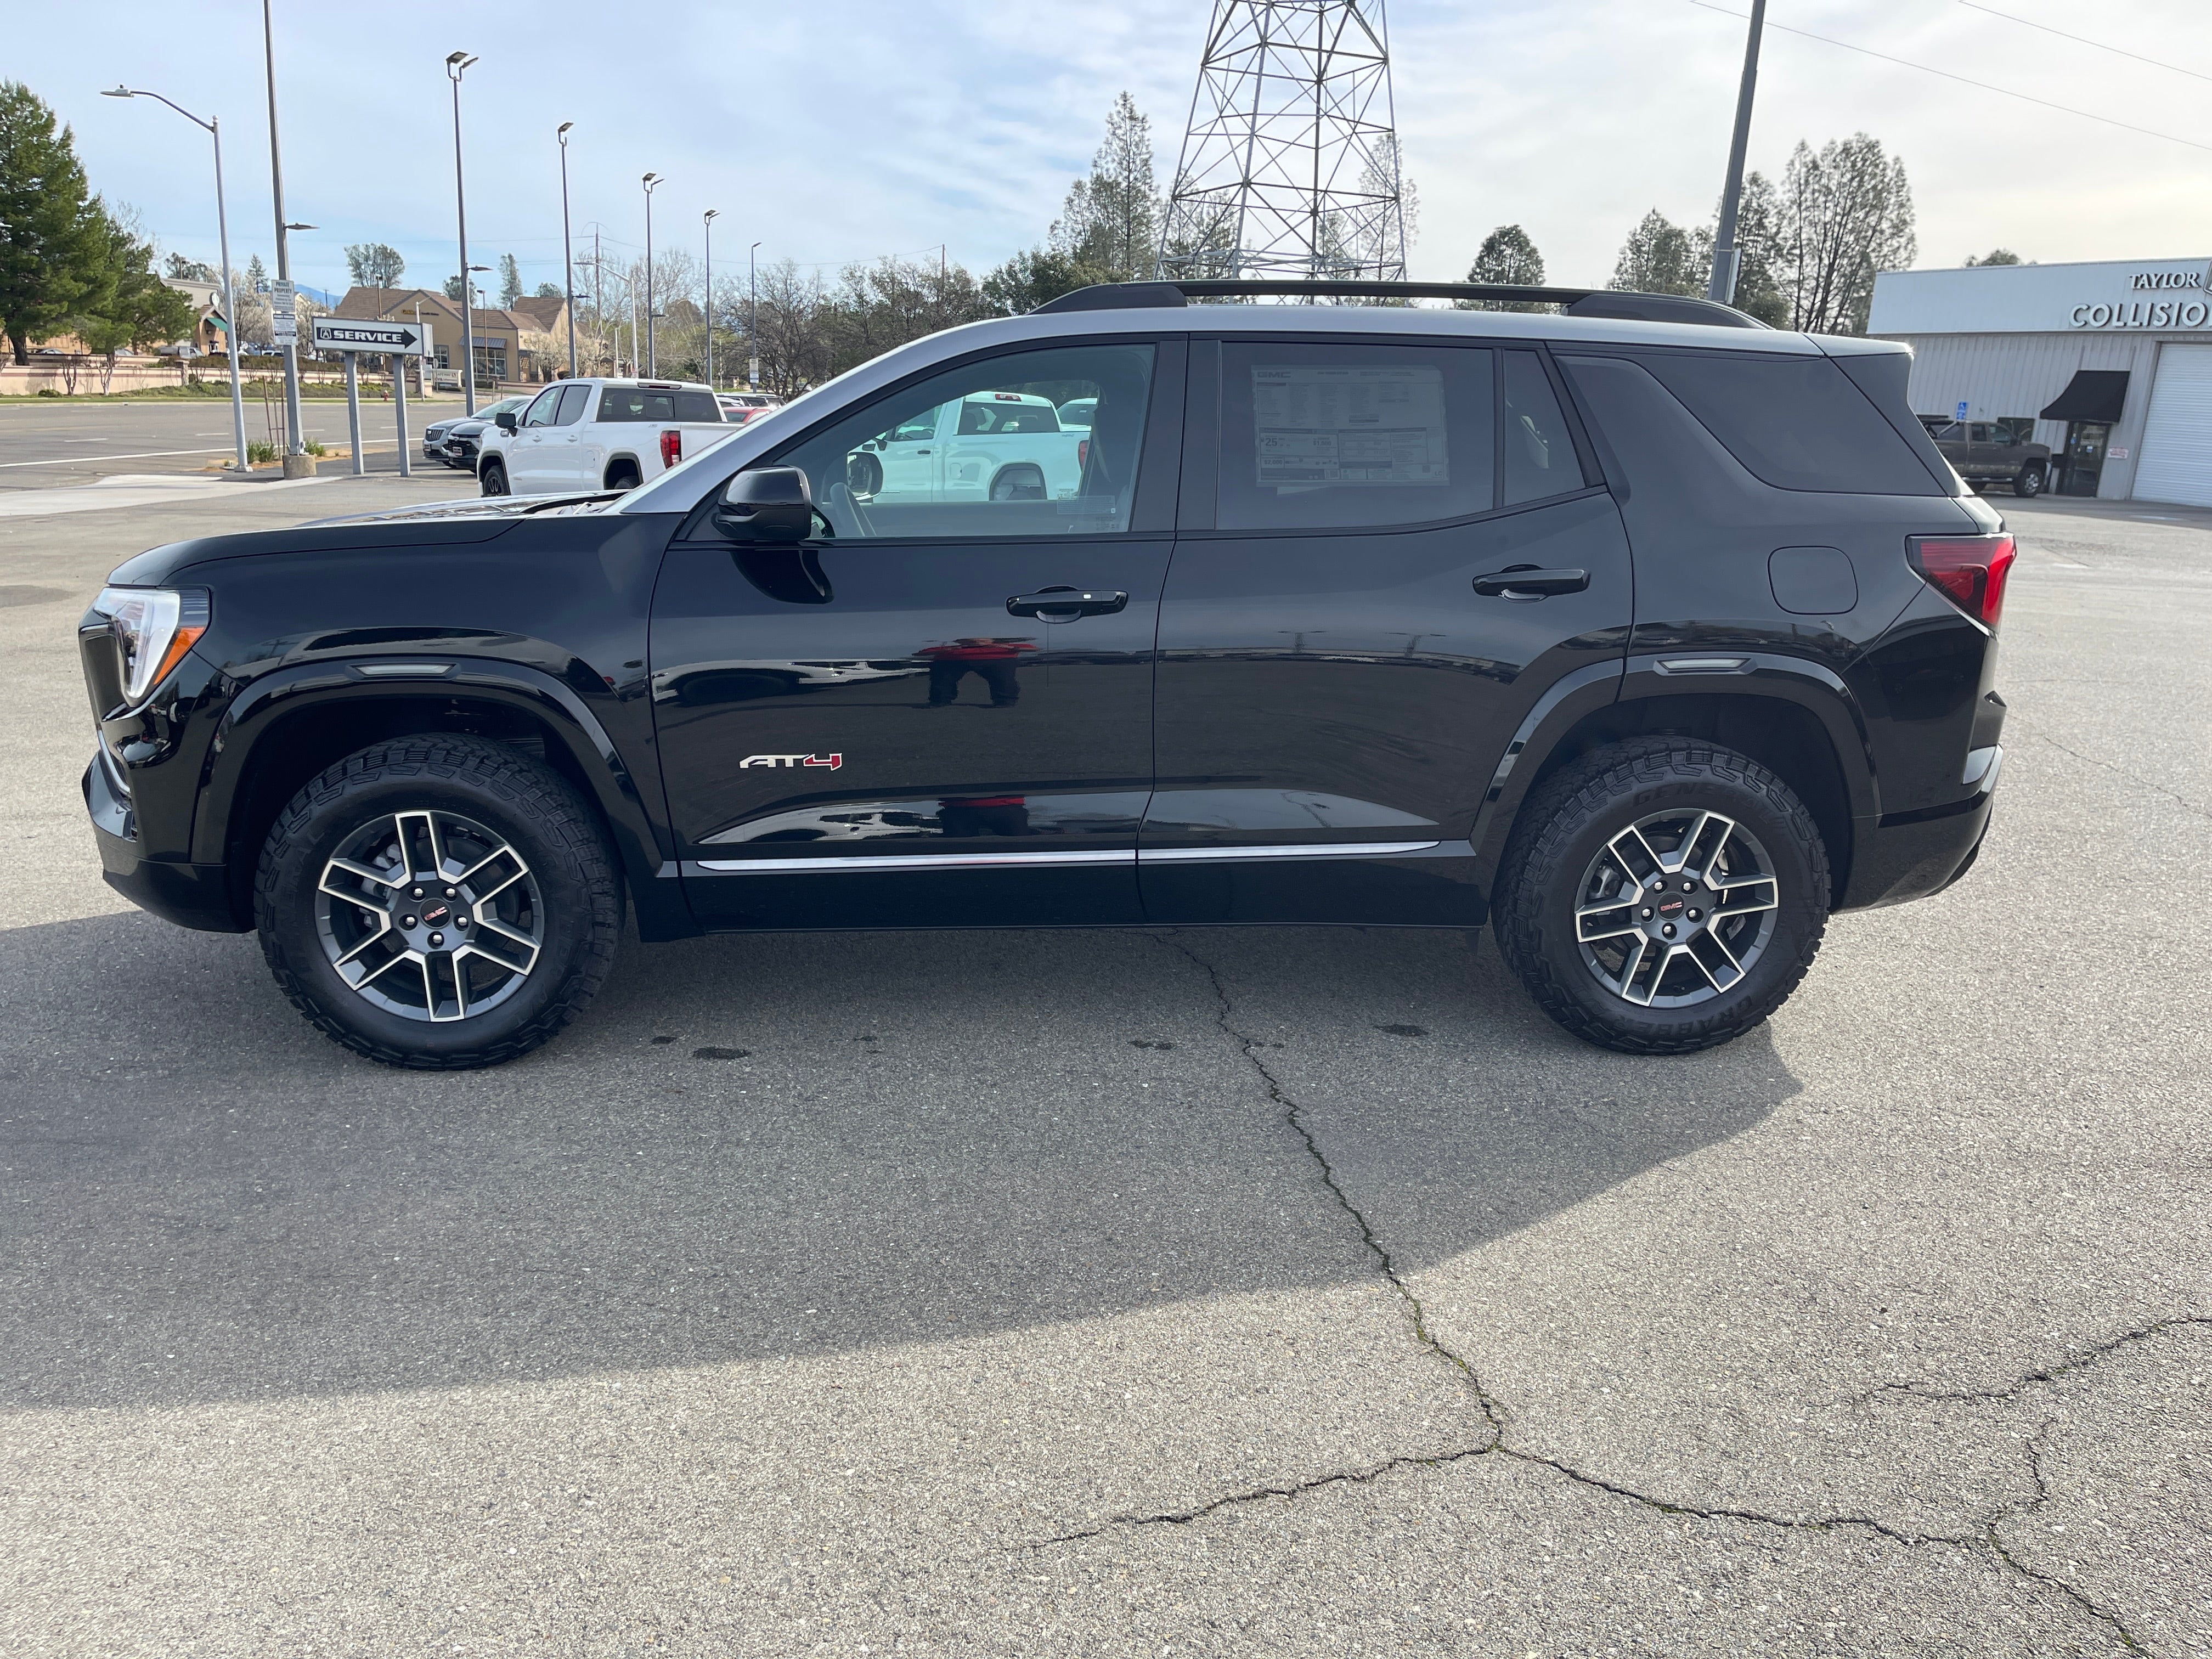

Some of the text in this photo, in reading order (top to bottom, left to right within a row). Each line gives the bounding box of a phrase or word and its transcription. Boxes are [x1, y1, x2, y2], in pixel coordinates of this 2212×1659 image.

[2129, 272, 2201, 289] TAYLOR
[2069, 302, 2212, 328] COLLISIO
[334, 330, 402, 342] SERVICE
[1266, 438, 1277, 447] 25
[739, 753, 842, 771] AT4
[1660, 901, 1683, 912] GMC
